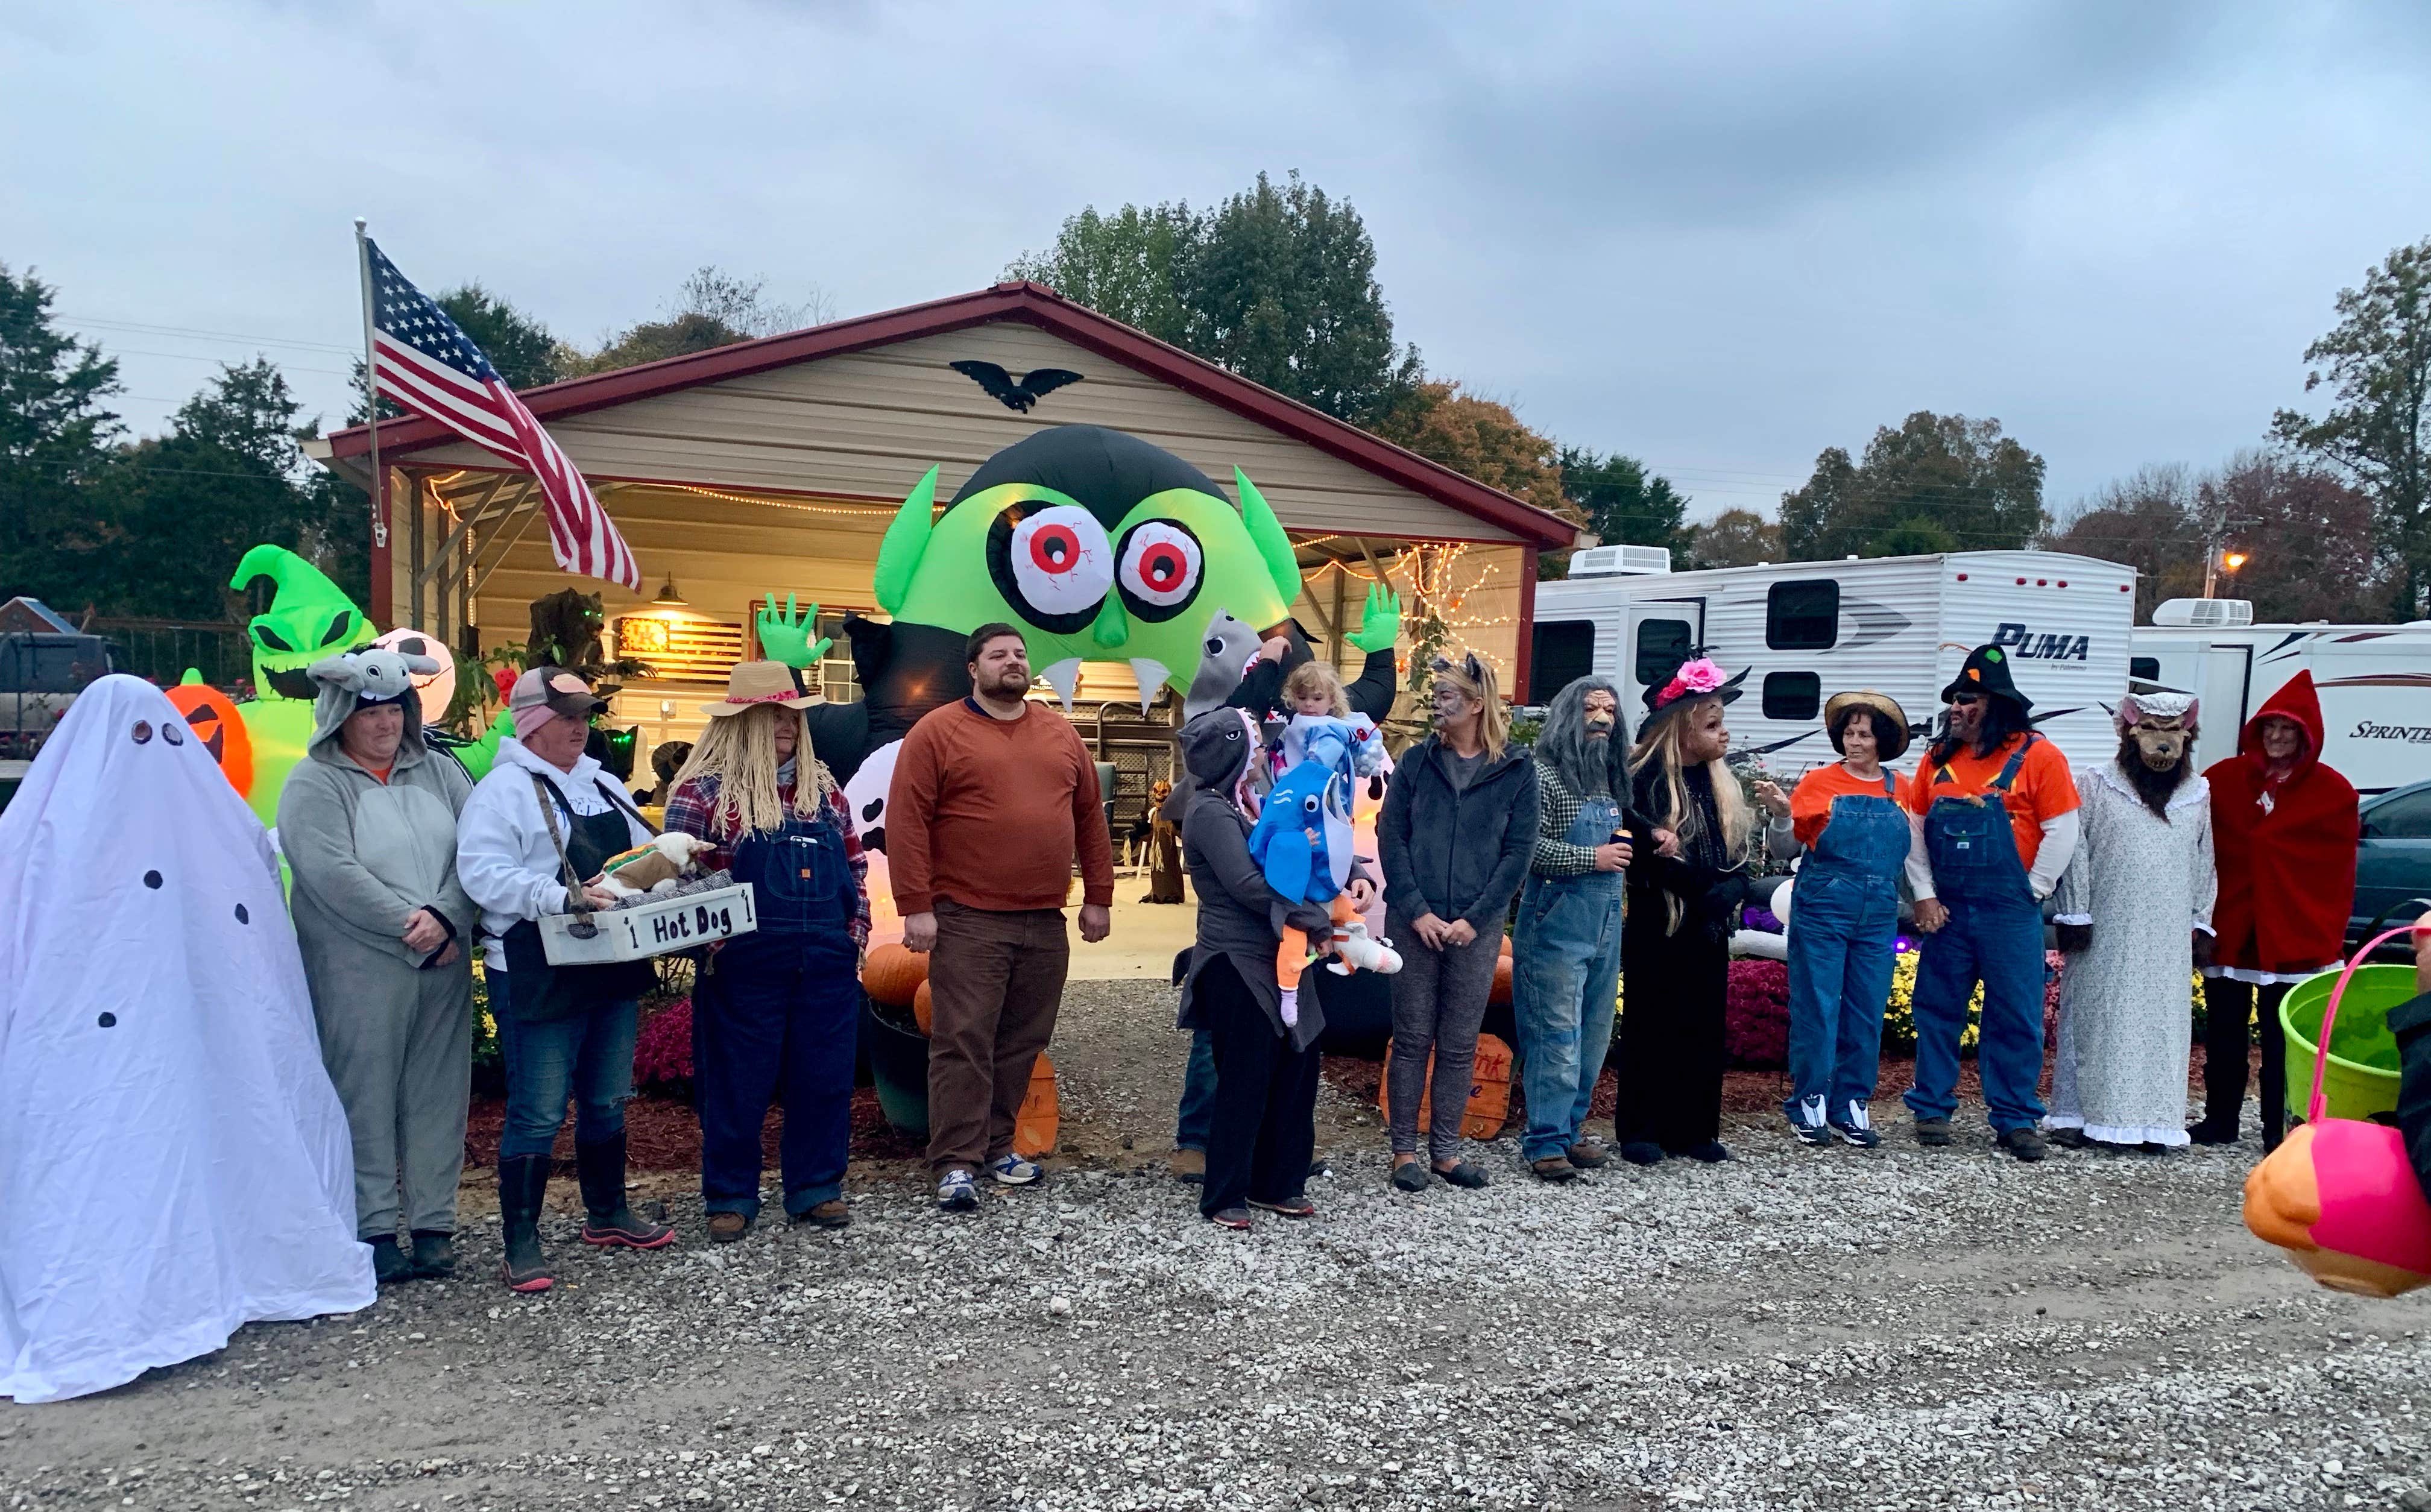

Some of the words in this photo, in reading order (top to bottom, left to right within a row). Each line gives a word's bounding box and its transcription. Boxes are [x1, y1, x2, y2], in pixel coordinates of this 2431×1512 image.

[1990, 623, 2089, 660] PUMA
[653, 912, 690, 943] Hot
[695, 906, 732, 936] Dog
